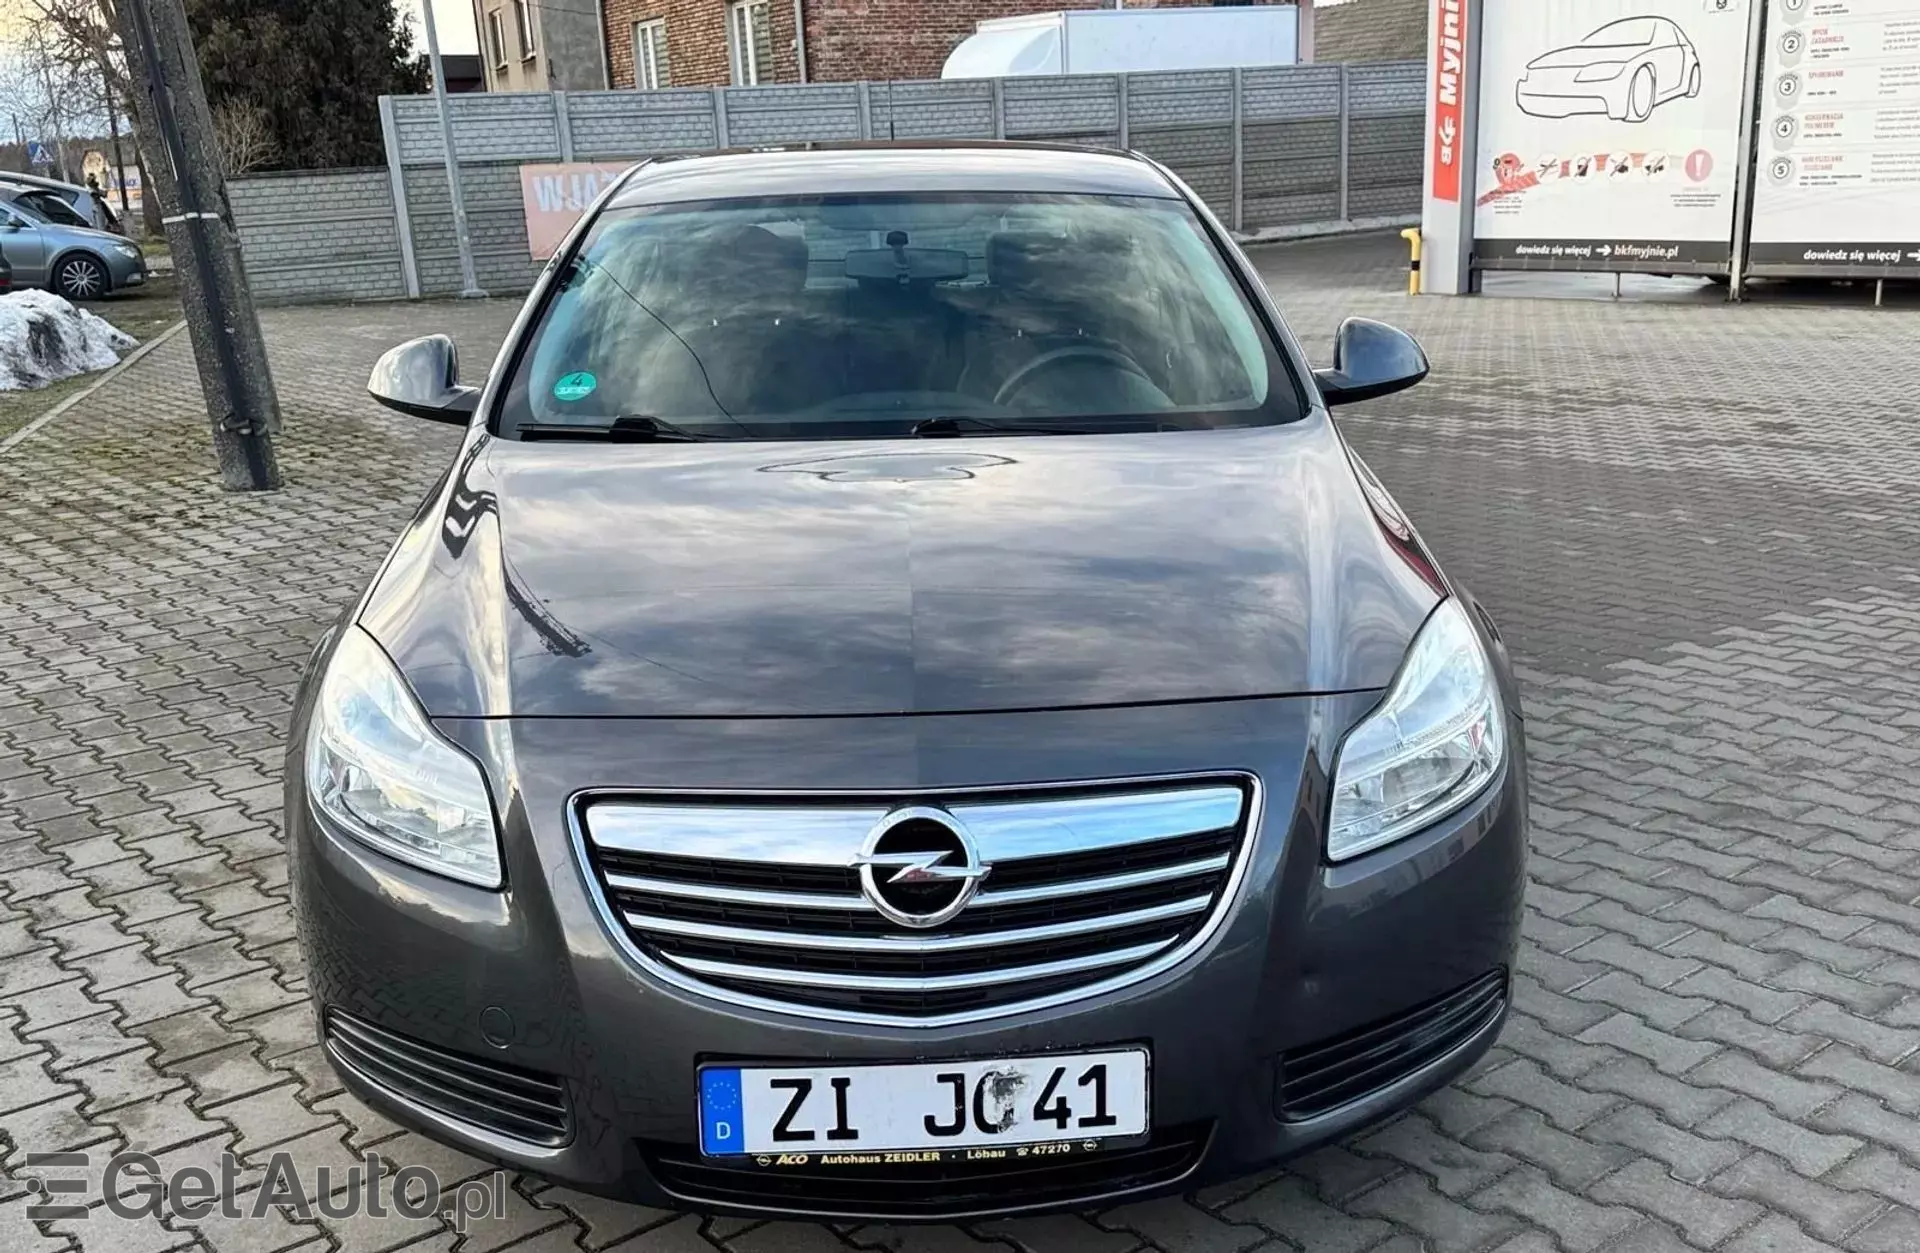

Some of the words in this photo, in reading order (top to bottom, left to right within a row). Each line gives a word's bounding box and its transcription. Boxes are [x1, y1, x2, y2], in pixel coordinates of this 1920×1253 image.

[532, 173, 618, 212] WJA
[1515, 244, 1550, 255] dowiedz
[1565, 244, 1592, 258] więcej
[1614, 244, 1679, 259] bkfmyjnie.pl
[1803, 249, 1848, 260] dowiedz
[1849, 249, 1865, 262] się
[1867, 249, 1902, 263] więcej
[770, 1077, 859, 1142] ZI
[1032, 1064, 1117, 1130] 41
[715, 1121, 731, 1140] D
[776, 1153, 808, 1165] ACO
[820, 1152, 881, 1165] Autohaus
[884, 1151, 940, 1163] ZEIDLER
[967, 1147, 1006, 1160] Löbau
[1031, 1143, 1071, 1155] 47270
